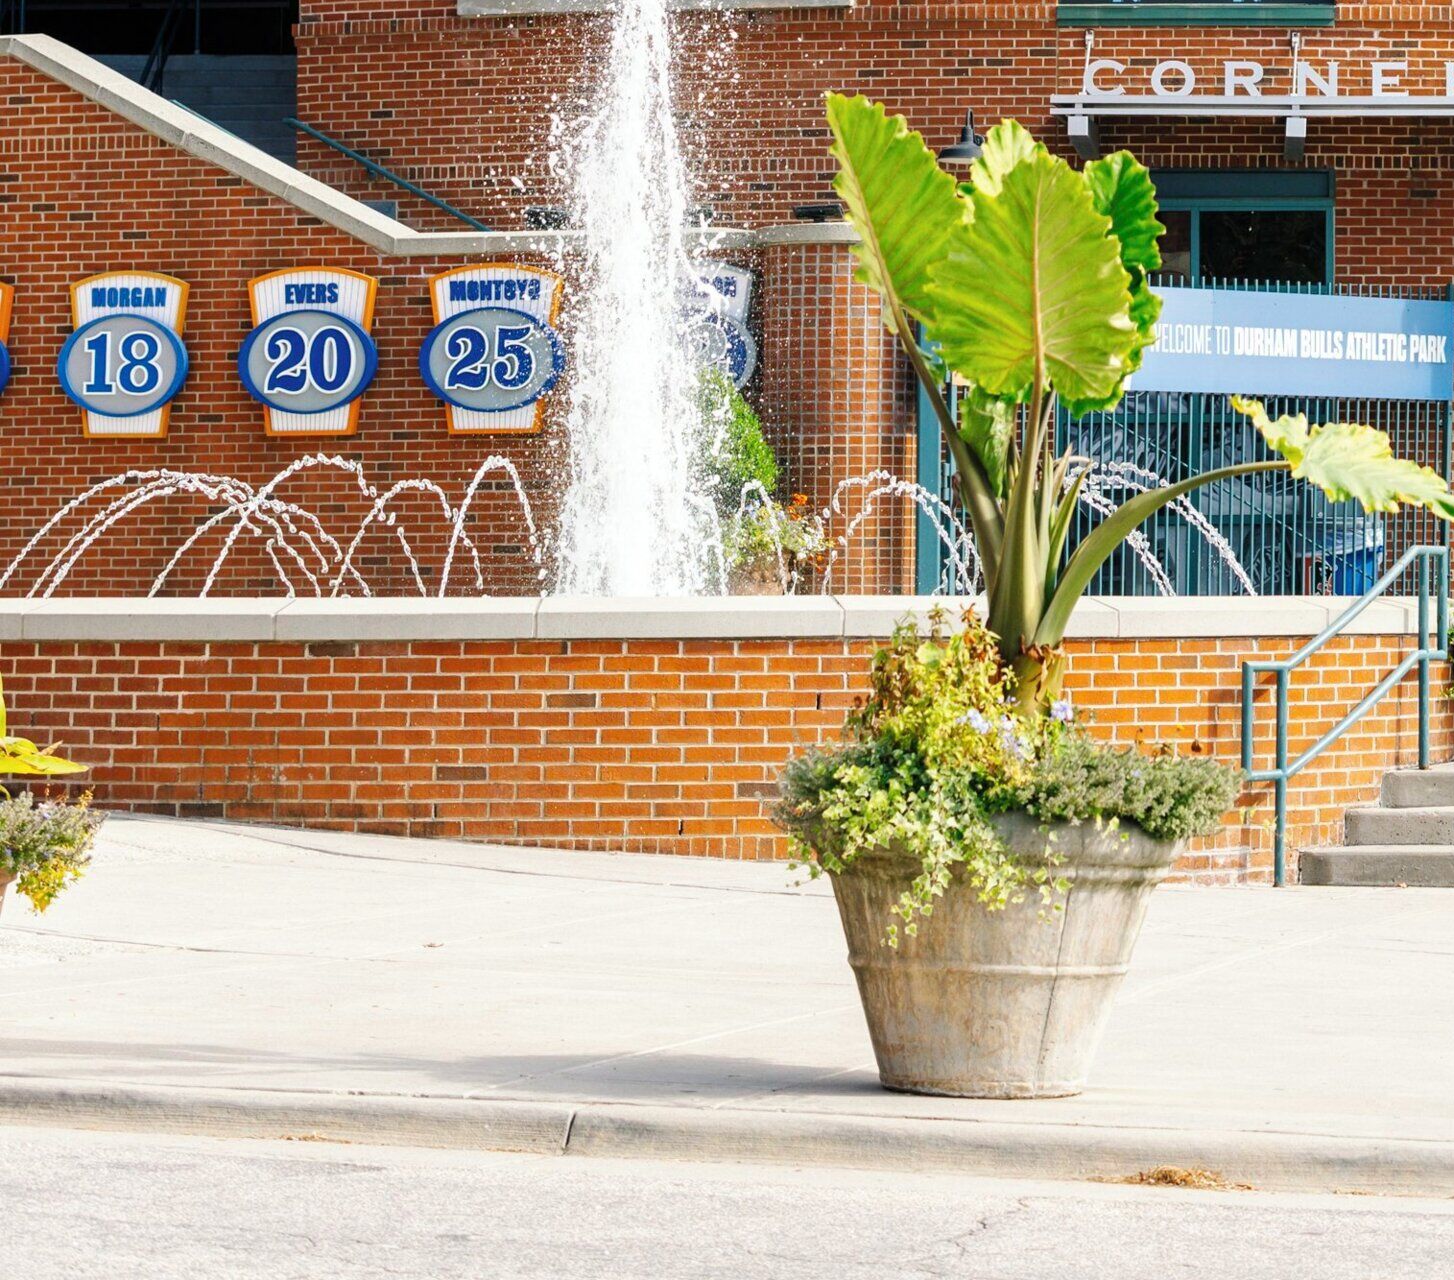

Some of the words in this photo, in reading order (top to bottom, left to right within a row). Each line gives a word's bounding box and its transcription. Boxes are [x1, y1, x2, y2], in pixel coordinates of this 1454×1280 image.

[91, 287, 167, 308] MORGAN
[284, 283, 339, 304] EVERS
[83, 330, 163, 396] 18
[264, 325, 356, 395] 20
[444, 325, 537, 391] 25
[1151, 323, 1212, 355] WELCOME
[1214, 325, 1230, 355] TO
[1234, 326, 1297, 358] DURHAM
[1300, 329, 1343, 360] BULLS
[1345, 331, 1407, 362] ATHLETIC
[1409, 334, 1447, 364] PARK
